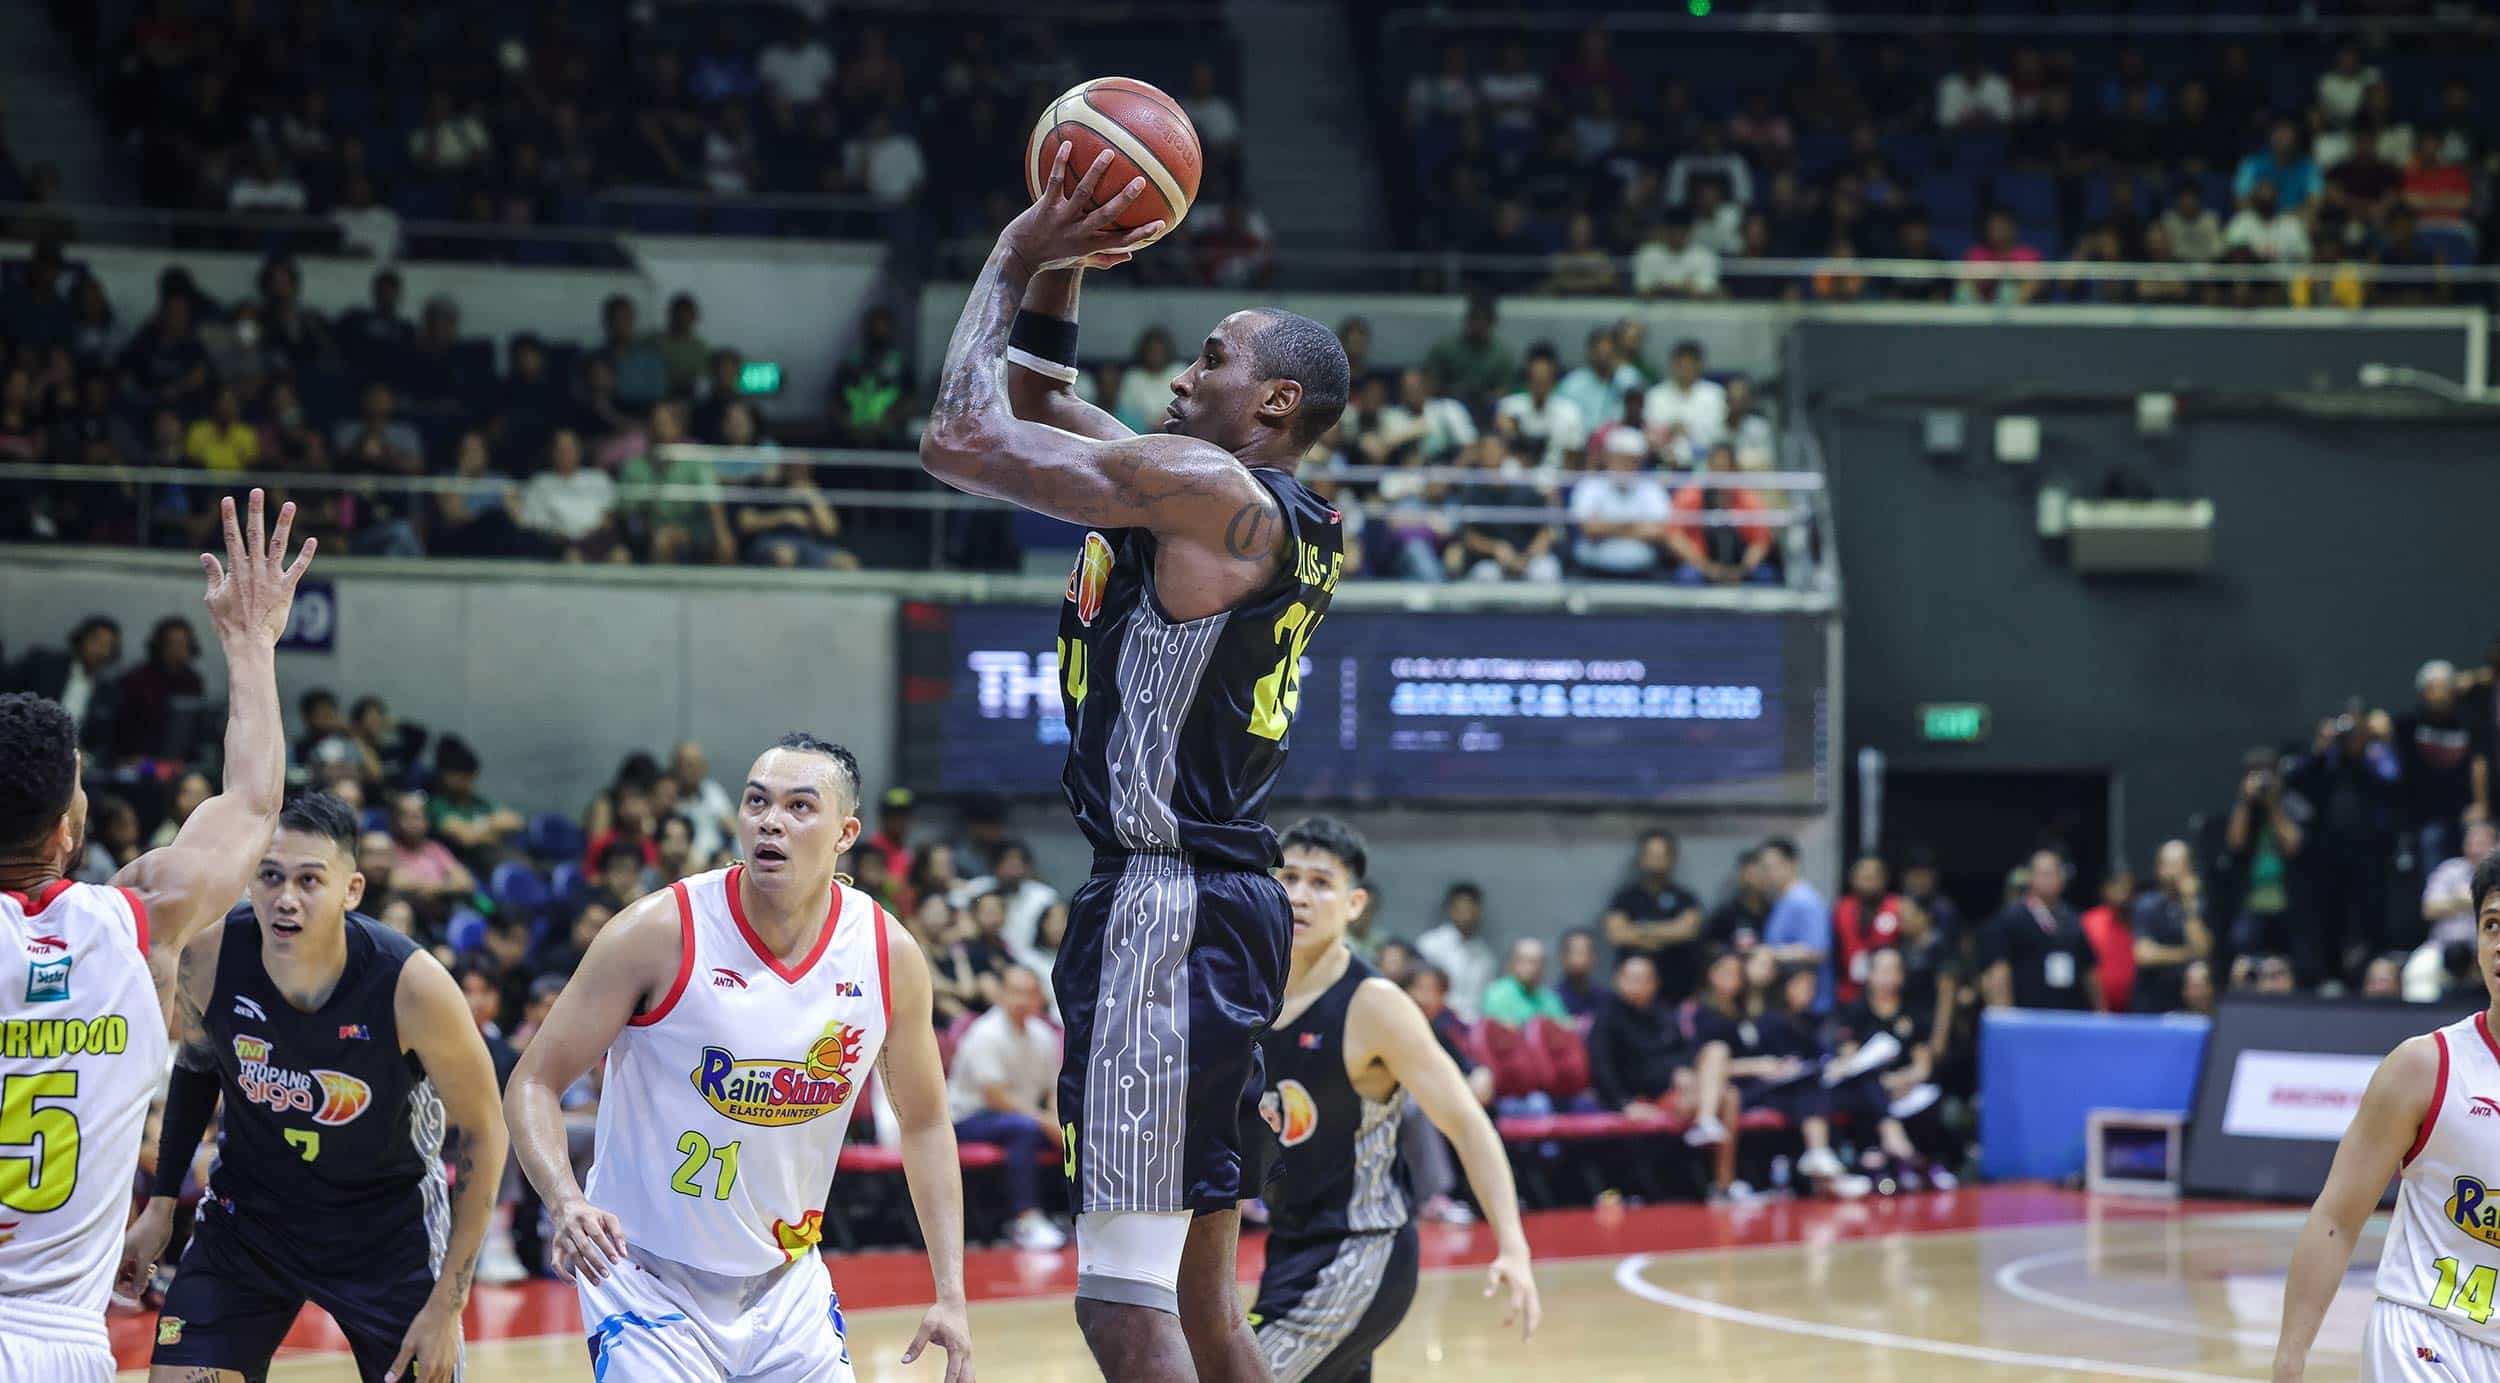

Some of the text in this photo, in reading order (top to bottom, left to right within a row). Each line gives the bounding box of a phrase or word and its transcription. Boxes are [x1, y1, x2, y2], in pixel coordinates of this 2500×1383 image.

[713, 976, 735, 989] ANTA
[0, 1014, 128, 1057] RWOOD
[240, 1062, 312, 1090] TROPANG
[759, 1070, 772, 1081] OR
[769, 1067, 852, 1106] Shine
[728, 1103, 820, 1119] ELASTO PAINTERS
[2469, 1106, 2492, 1117] ANTA
[0, 1071, 81, 1213] 5
[283, 1127, 320, 1162] 7
[671, 1131, 741, 1201] 21
[2429, 1256, 2498, 1325] 14
